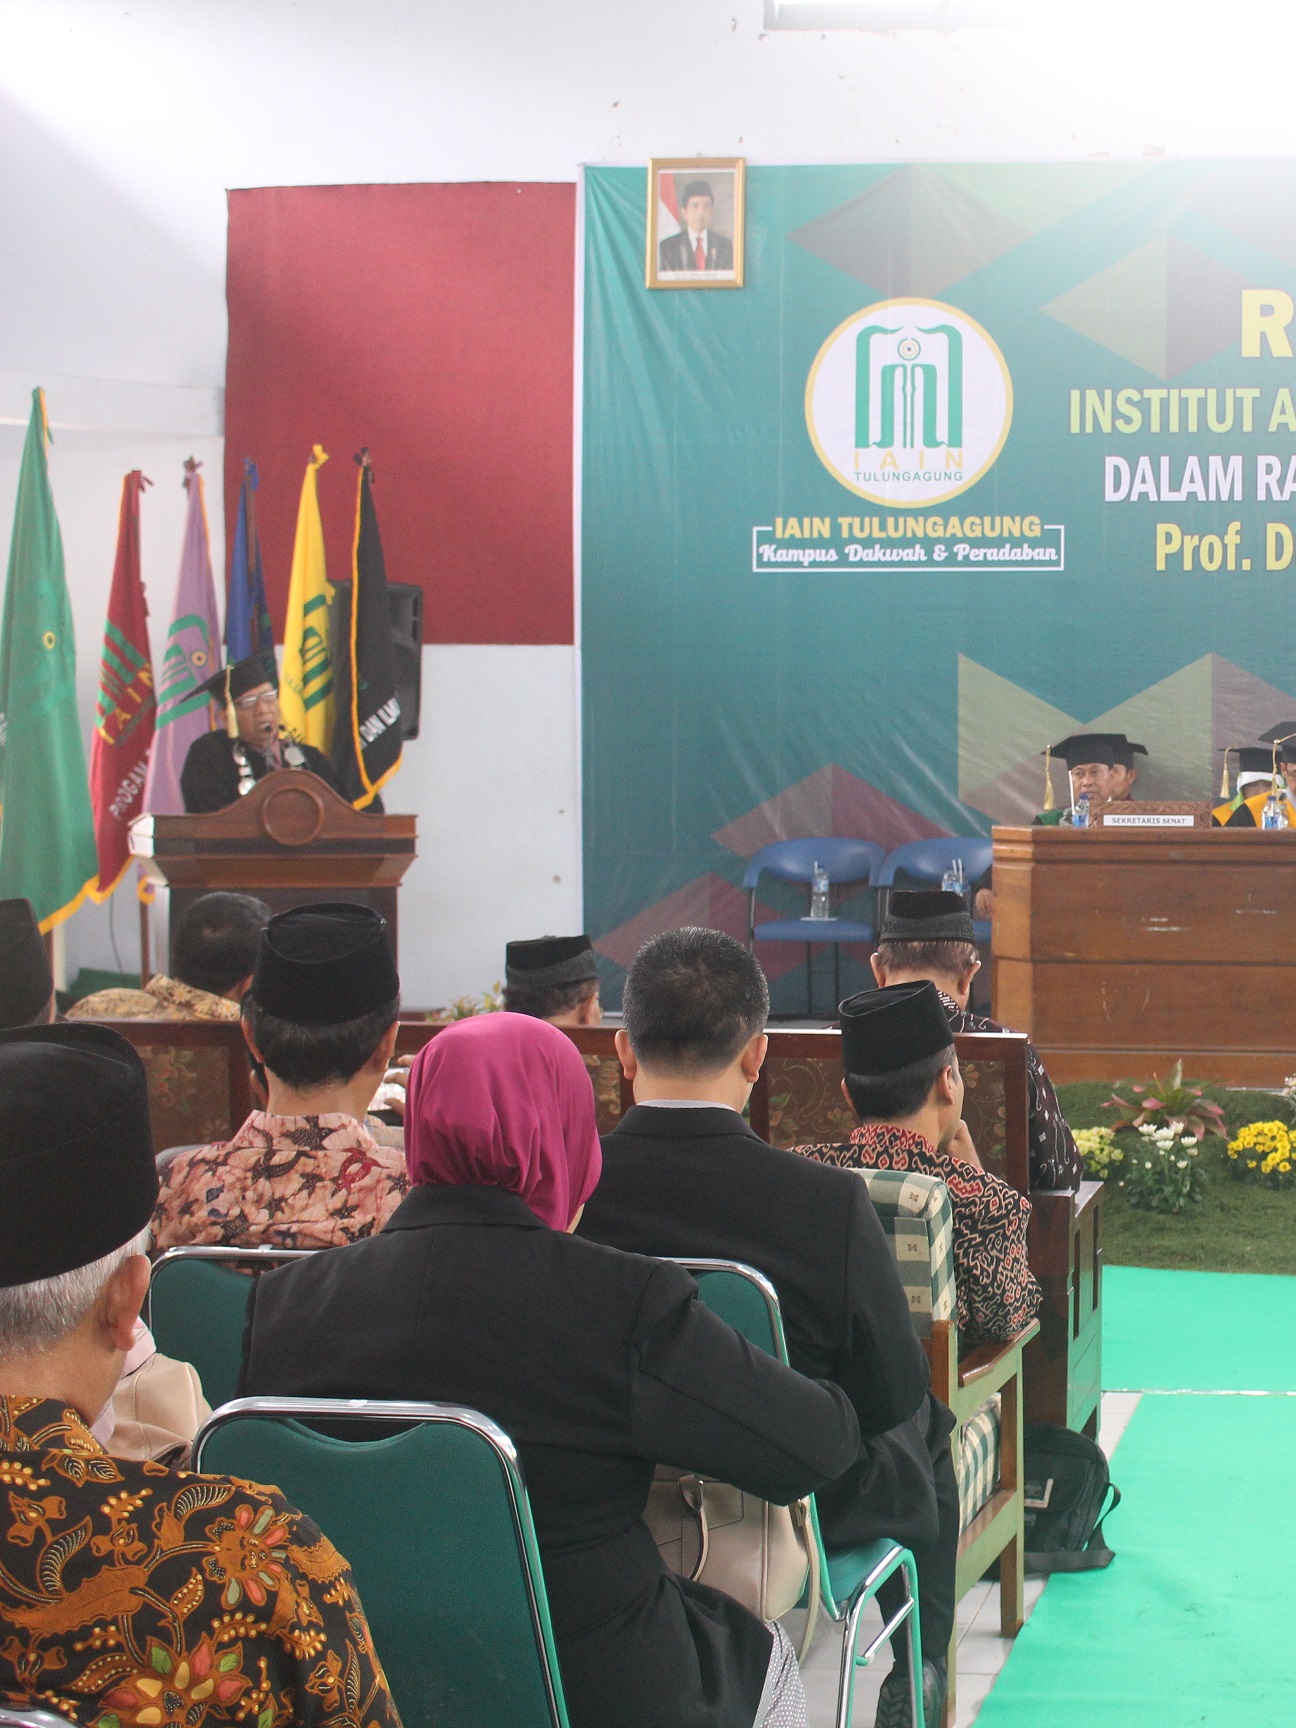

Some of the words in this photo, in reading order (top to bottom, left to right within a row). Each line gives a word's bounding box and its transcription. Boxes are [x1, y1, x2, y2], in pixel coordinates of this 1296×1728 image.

[1070, 386, 1261, 434] INSTITUT
[853, 449, 965, 471] IAIN
[854, 471, 964, 482] TULUNGAGUNG
[1104, 454, 1243, 502] DALAM
[774, 516, 831, 539] IAIN
[837, 515, 1042, 539] TULUNGAGUNG
[758, 543, 838, 566] Kampus
[844, 543, 928, 562] Dakwah
[932, 543, 949, 562] &
[952, 542, 1059, 562] Peradaban
[1155, 521, 1252, 572] Prof.
[1111, 817, 1161, 825] SEKRETARIS
